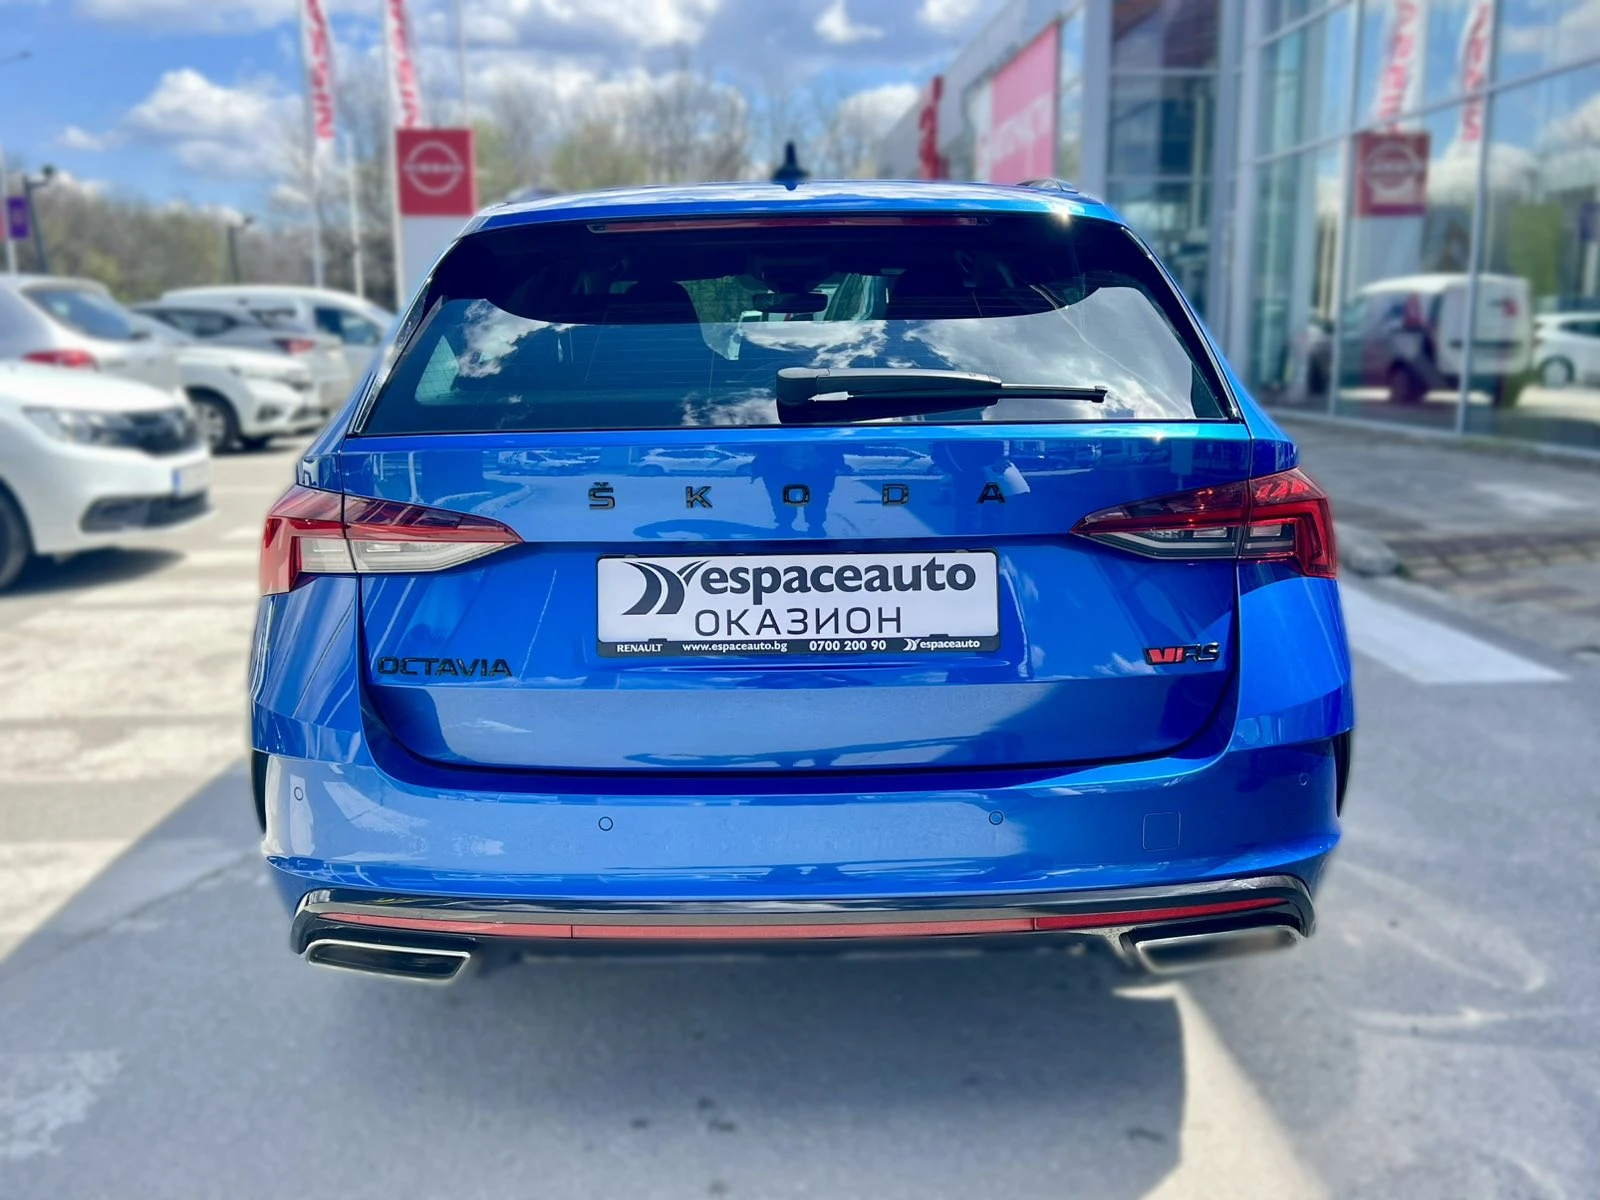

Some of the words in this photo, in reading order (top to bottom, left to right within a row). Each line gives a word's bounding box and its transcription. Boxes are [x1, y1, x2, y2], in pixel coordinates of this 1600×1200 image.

[588, 481, 1006, 510] ŠKODA
[700, 556, 976, 605] espaceauto
[694, 606, 902, 637] ОКАЗИОН
[616, 643, 664, 653] RENAULT
[682, 640, 788, 653] www.espaceauto.bg
[809, 640, 840, 651] 0700
[843, 640, 867, 651] 200
[871, 640, 887, 651] 90
[919, 639, 981, 651] espaceauto
[377, 656, 513, 677] OCTAVIA
